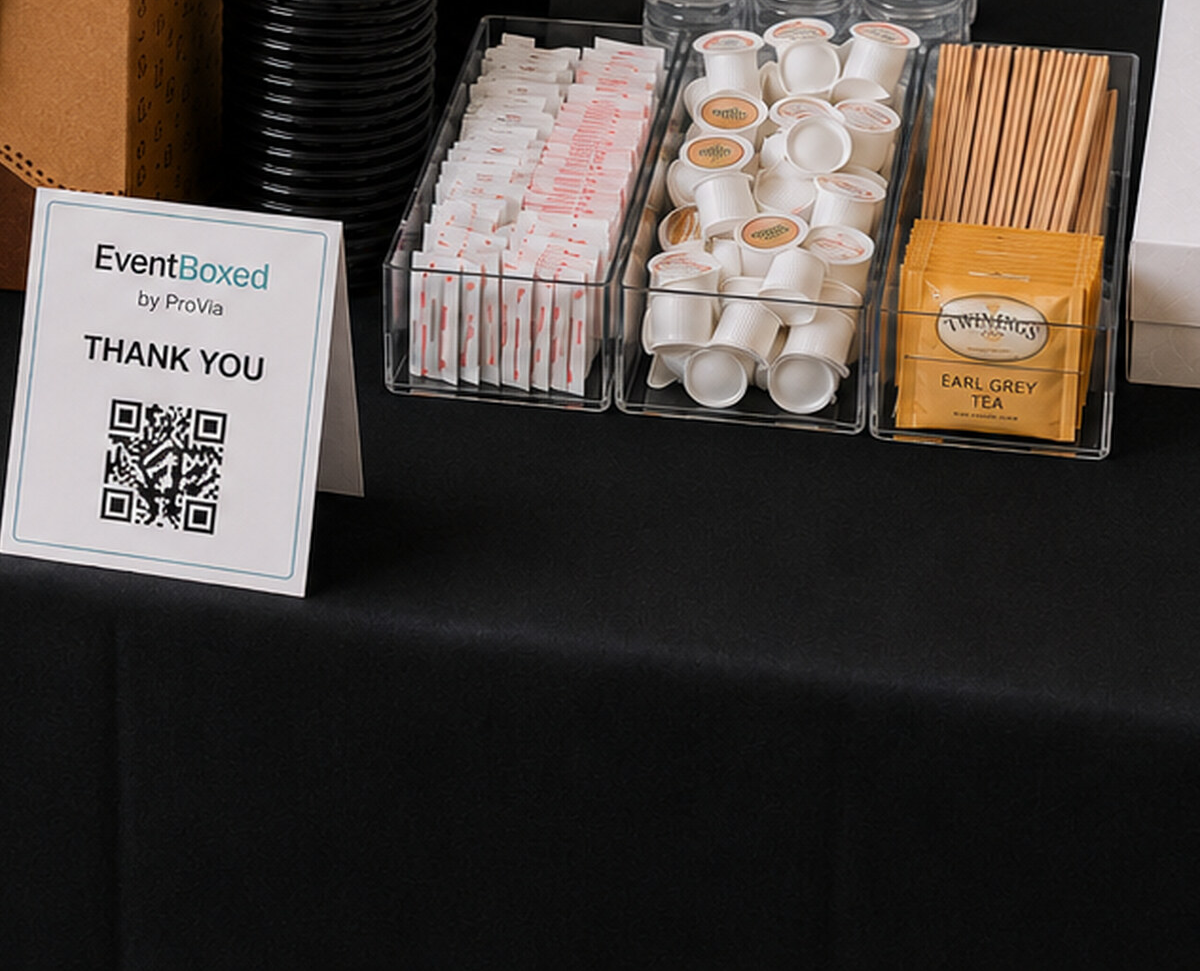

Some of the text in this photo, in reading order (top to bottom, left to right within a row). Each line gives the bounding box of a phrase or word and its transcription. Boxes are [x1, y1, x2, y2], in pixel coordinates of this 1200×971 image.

[94, 243, 270, 291] EventBoxed
[137, 290, 224, 317] by ProVia
[84, 334, 265, 381] THANK YOU
[941, 373, 1039, 395] EARL GREY
[970, 393, 1004, 410] TEA
